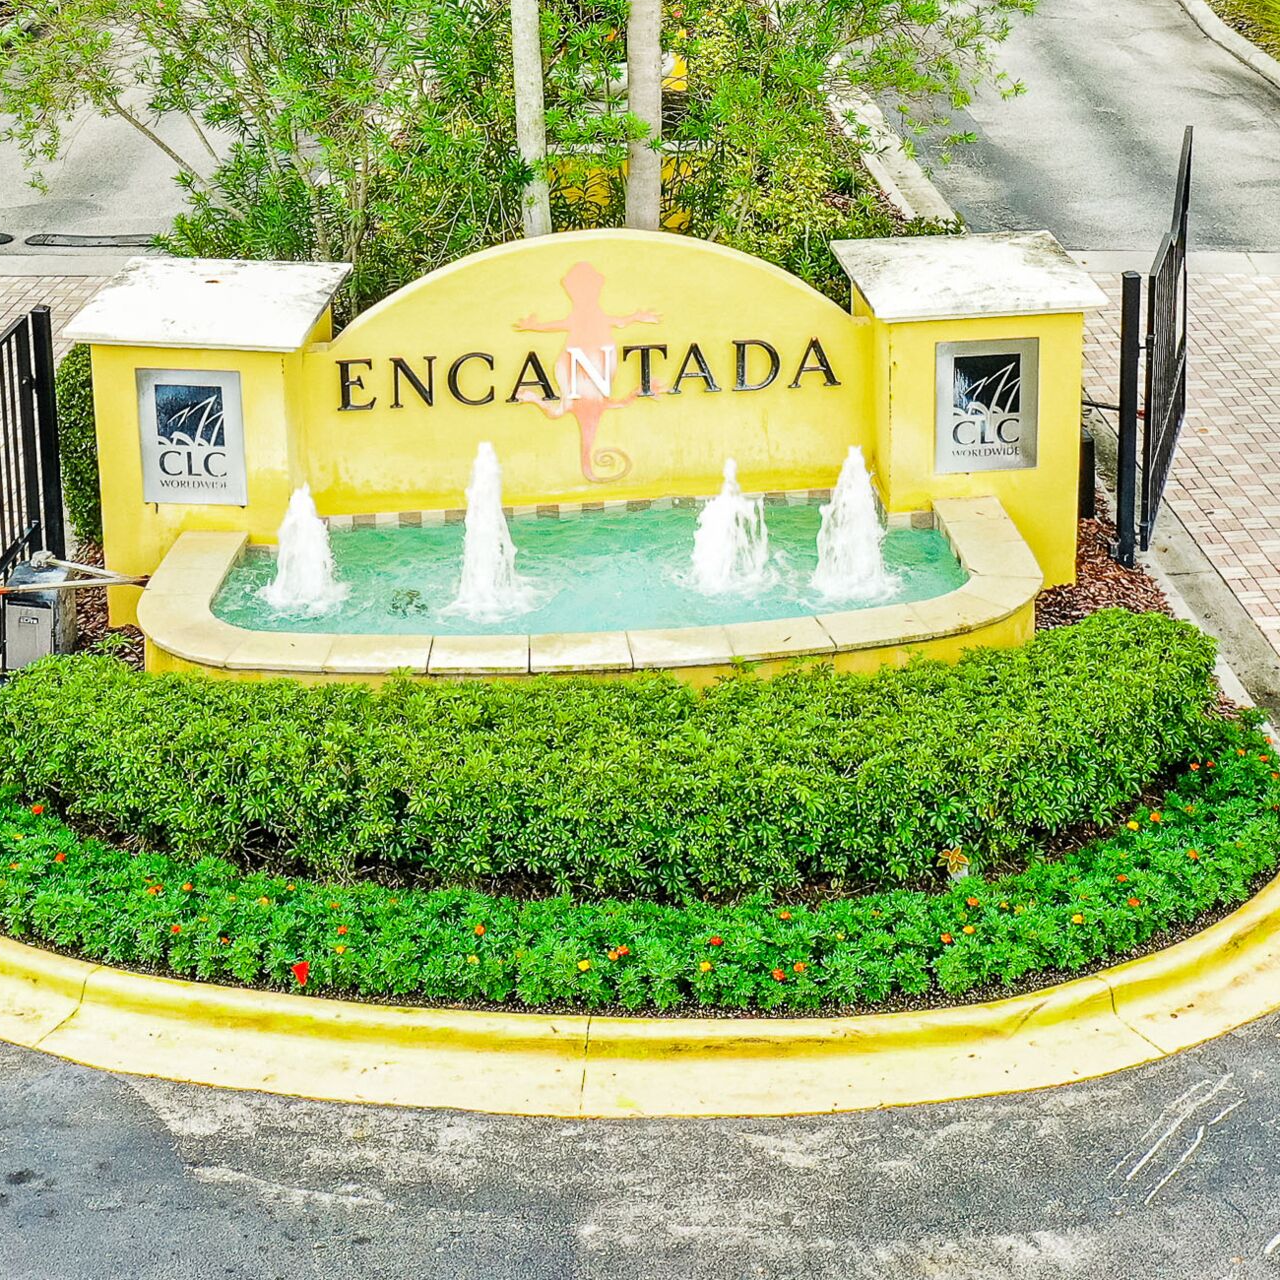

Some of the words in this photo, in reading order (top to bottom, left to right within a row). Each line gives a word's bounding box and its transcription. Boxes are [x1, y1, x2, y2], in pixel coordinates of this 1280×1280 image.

[336, 336, 842, 411] ENCANTADA
[952, 417, 1020, 445] CLC
[159, 450, 227, 477] CLC
[952, 446, 1020, 457] WORLDWIDE
